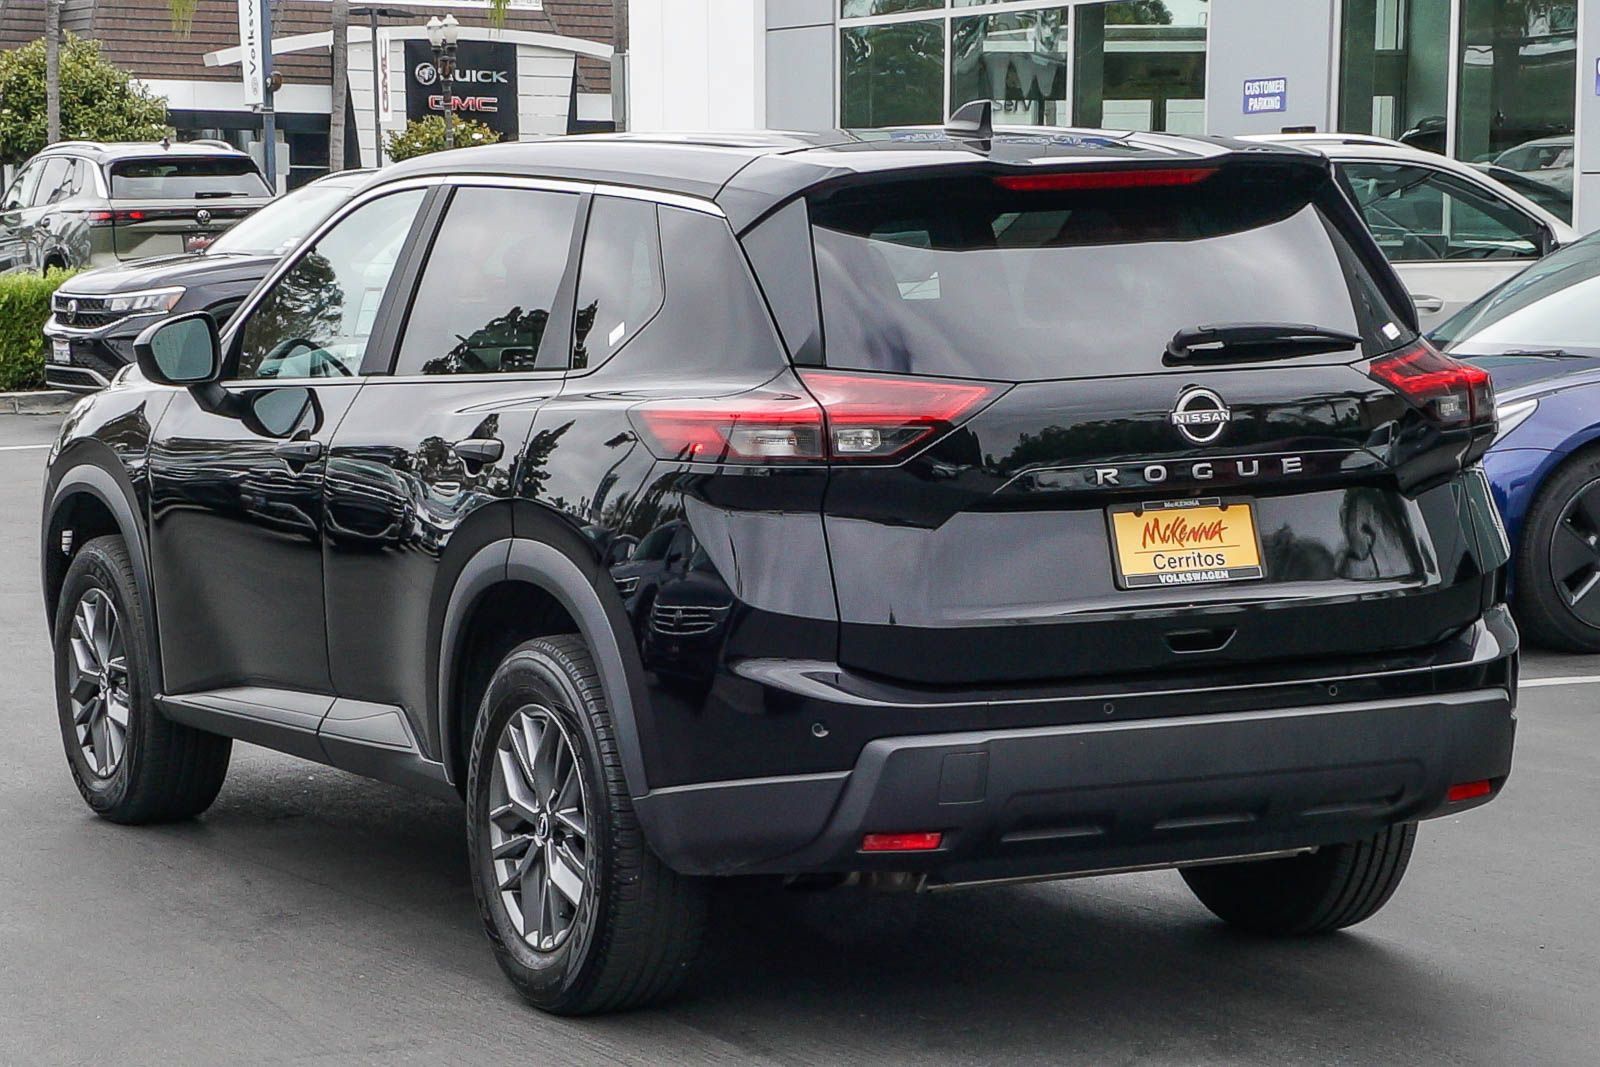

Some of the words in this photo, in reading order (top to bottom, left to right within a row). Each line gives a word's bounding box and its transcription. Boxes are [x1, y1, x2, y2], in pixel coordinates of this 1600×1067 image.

[1245, 80, 1285, 95] CUSTOMER
[428, 94, 498, 113] GMC
[1248, 96, 1281, 111] PARKING
[1171, 410, 1231, 425] NISSAN
[1095, 456, 1303, 486] ROGUE
[1153, 552, 1225, 570] Cerritos
[1158, 570, 1229, 584] VOLKSWAGEN
